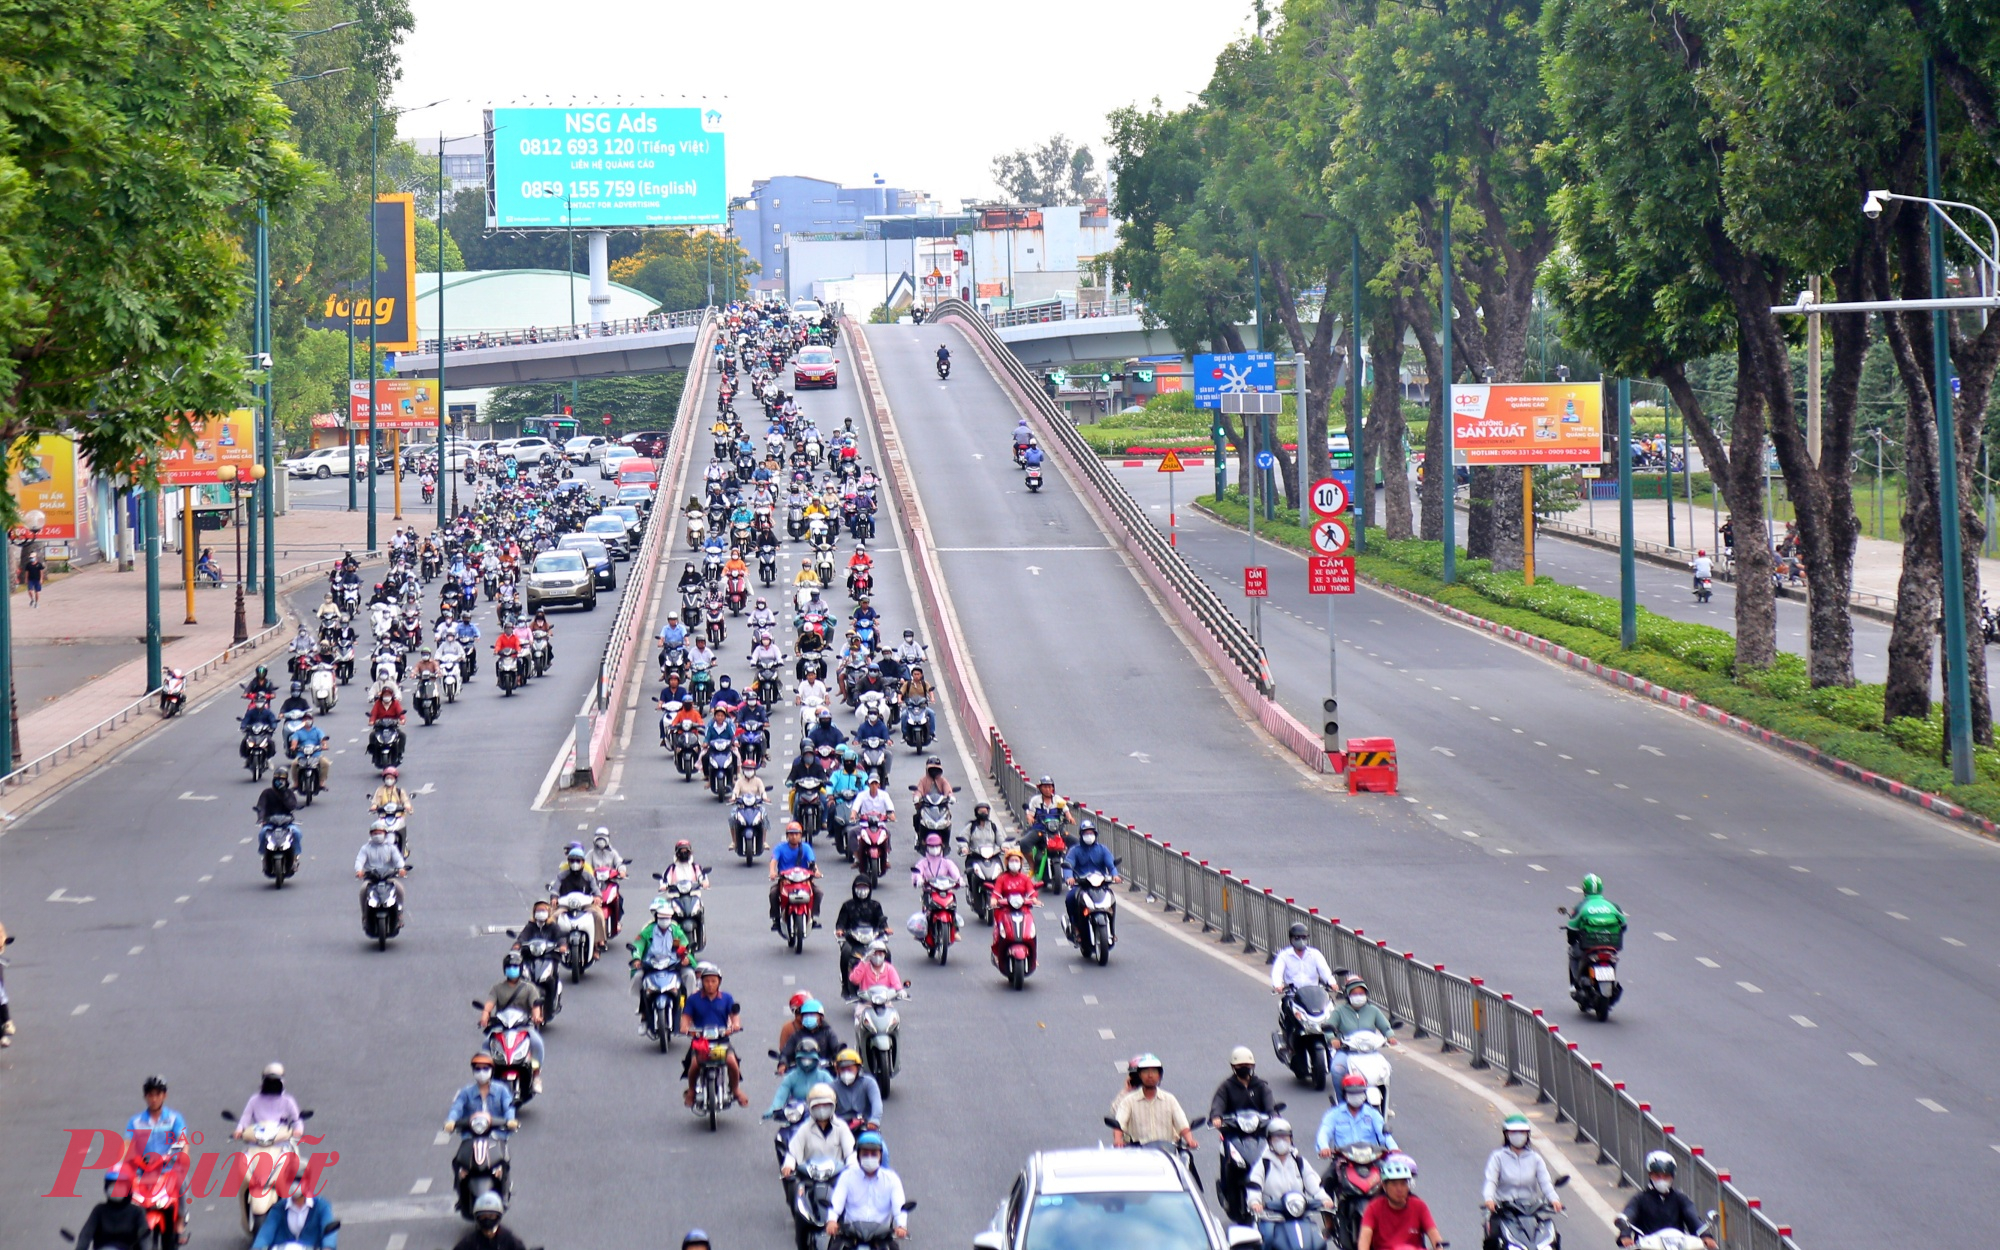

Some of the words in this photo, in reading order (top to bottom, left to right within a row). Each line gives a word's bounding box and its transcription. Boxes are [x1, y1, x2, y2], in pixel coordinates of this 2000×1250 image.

[565, 113, 611, 133] NSG
[617, 112, 658, 133] Ads
[519, 138, 562, 156] 0812
[567, 138, 598, 156] 693
[604, 138, 634, 156] 120
[637, 140, 675, 156] (Tiếng
[680, 139, 709, 157] Việt)
[571, 159, 589, 169] LIÊN
[592, 159, 603, 171] HỆ
[605, 159, 635, 170] QUẢNG
[638, 158, 655, 169] CÁO
[521, 181, 563, 198] 0859
[569, 181, 599, 198] 155
[604, 180, 635, 197] 759
[638, 179, 697, 198] (English)
[1455, 394, 1479, 407] dpa
[381, 403, 392, 411] IN
[1478, 419, 1503, 427] XƯỞNG
[1457, 423, 1487, 438] SẢN
[1489, 422, 1527, 438] XUẤT
[45, 527, 62, 535] 246
[1319, 557, 1344, 568] CẤM
[1249, 568, 1262, 579] CẤM
[1331, 584, 1350, 592] THÔNG
[1587, 905, 1611, 915] Grab
